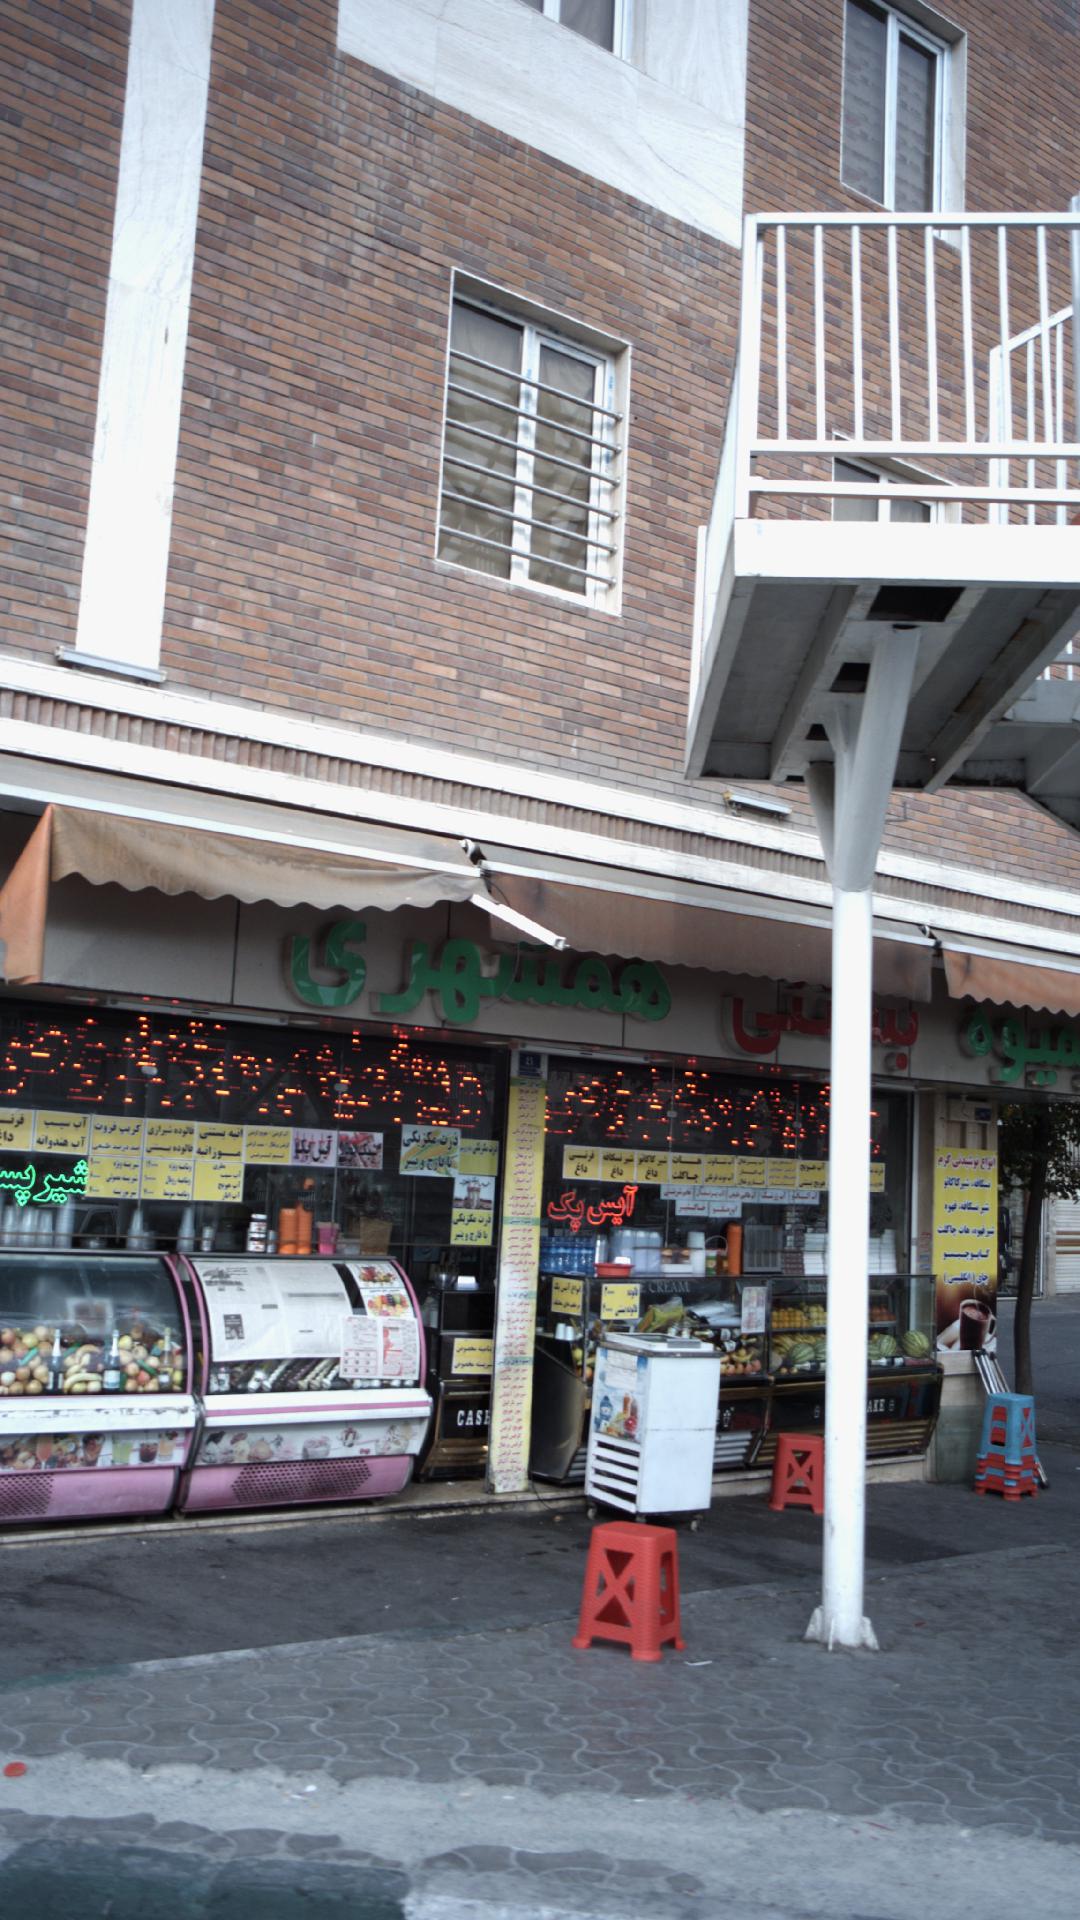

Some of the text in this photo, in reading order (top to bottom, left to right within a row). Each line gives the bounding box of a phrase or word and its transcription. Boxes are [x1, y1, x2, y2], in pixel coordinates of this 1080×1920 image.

[574, 1162, 588, 1176] داغ
[938, 1154, 996, 1171] انواع نوشیدنی گرم
[610, 1167, 624, 1178] داغ
[645, 1168, 658, 1180] داغ
[586, 1184, 639, 1226] آیس
[944, 1202, 957, 1213] قهوه
